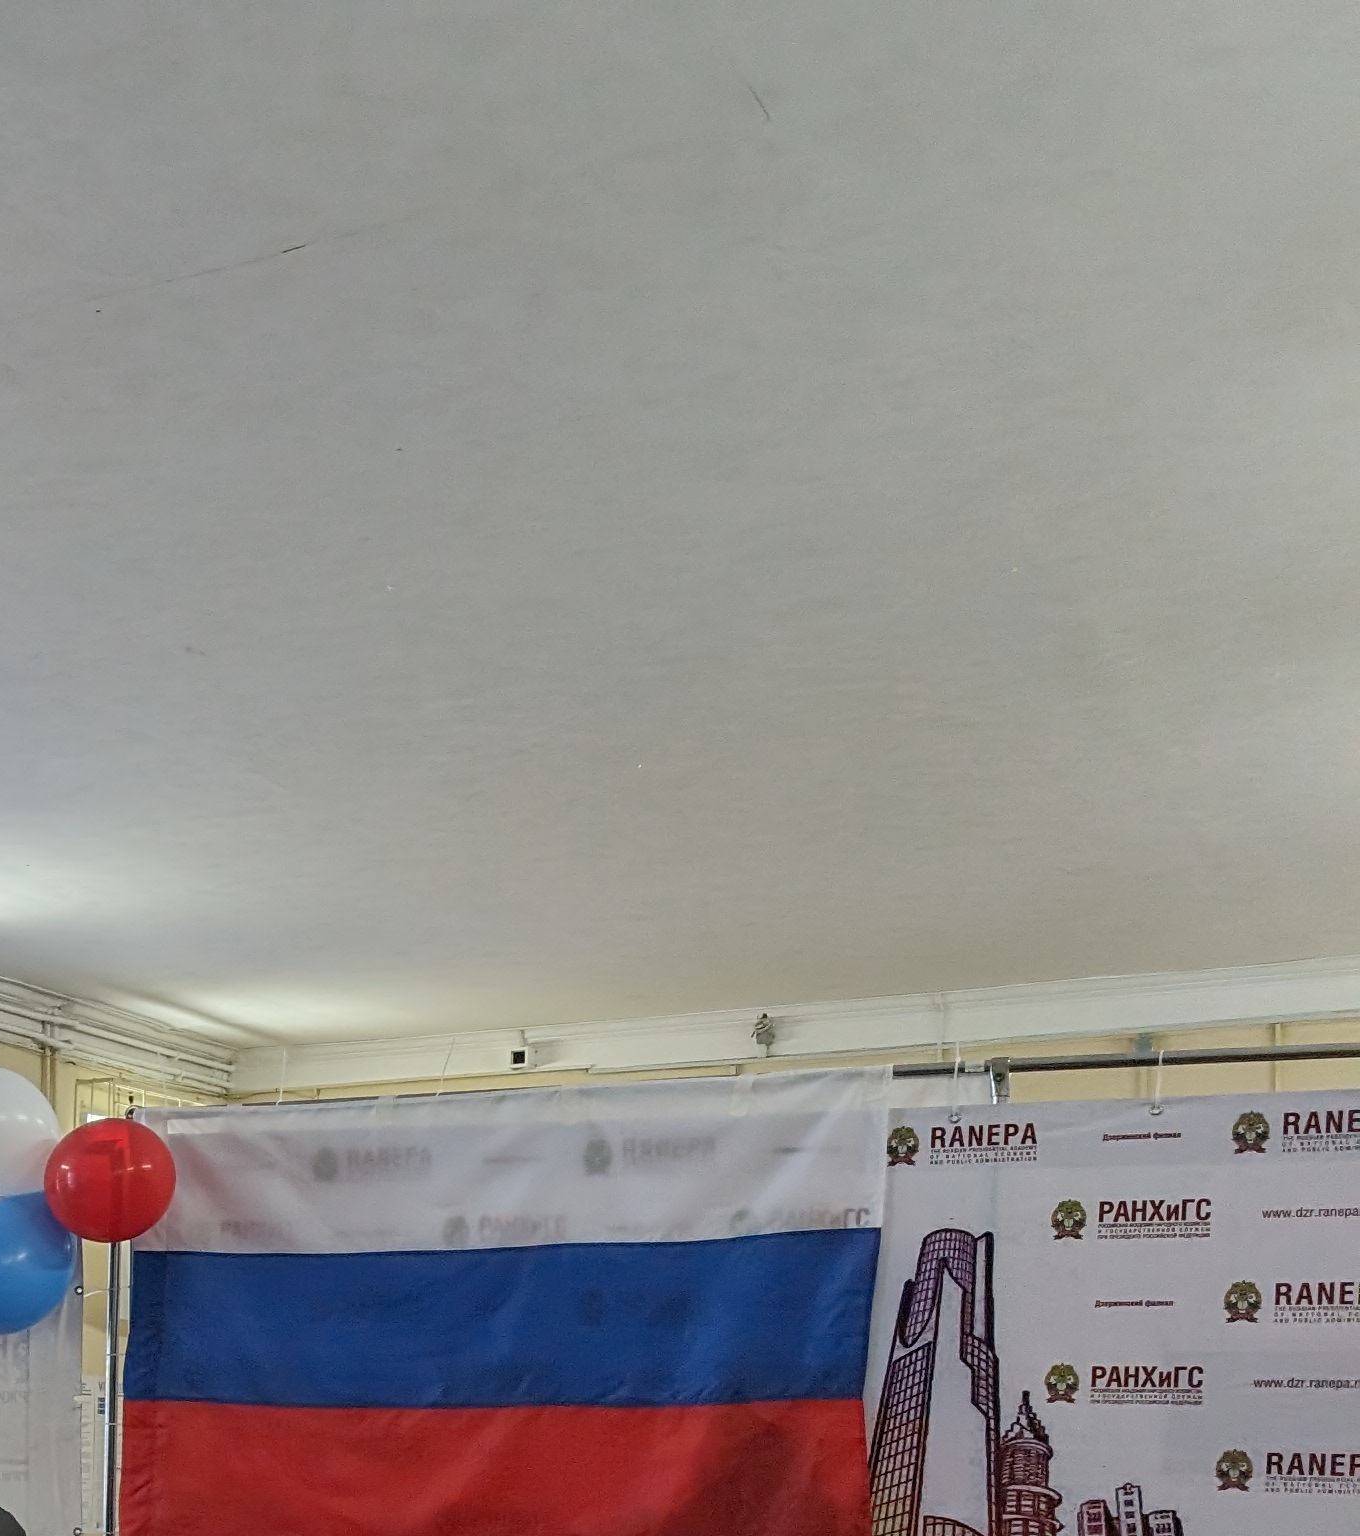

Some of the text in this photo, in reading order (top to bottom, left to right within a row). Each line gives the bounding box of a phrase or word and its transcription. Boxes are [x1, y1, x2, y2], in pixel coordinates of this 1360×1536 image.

[1283, 1109, 1360, 1135] RANE
[930, 1122, 1037, 1148] RANEPA
[1098, 1198, 1212, 1223] РАНХиГС
[1274, 1281, 1360, 1306] RANE
[1090, 1365, 1204, 1388] РАНХиГС
[1253, 1377, 1360, 1391] www.dzr.ranepa.r
[1265, 1452, 1360, 1477] RANEP
